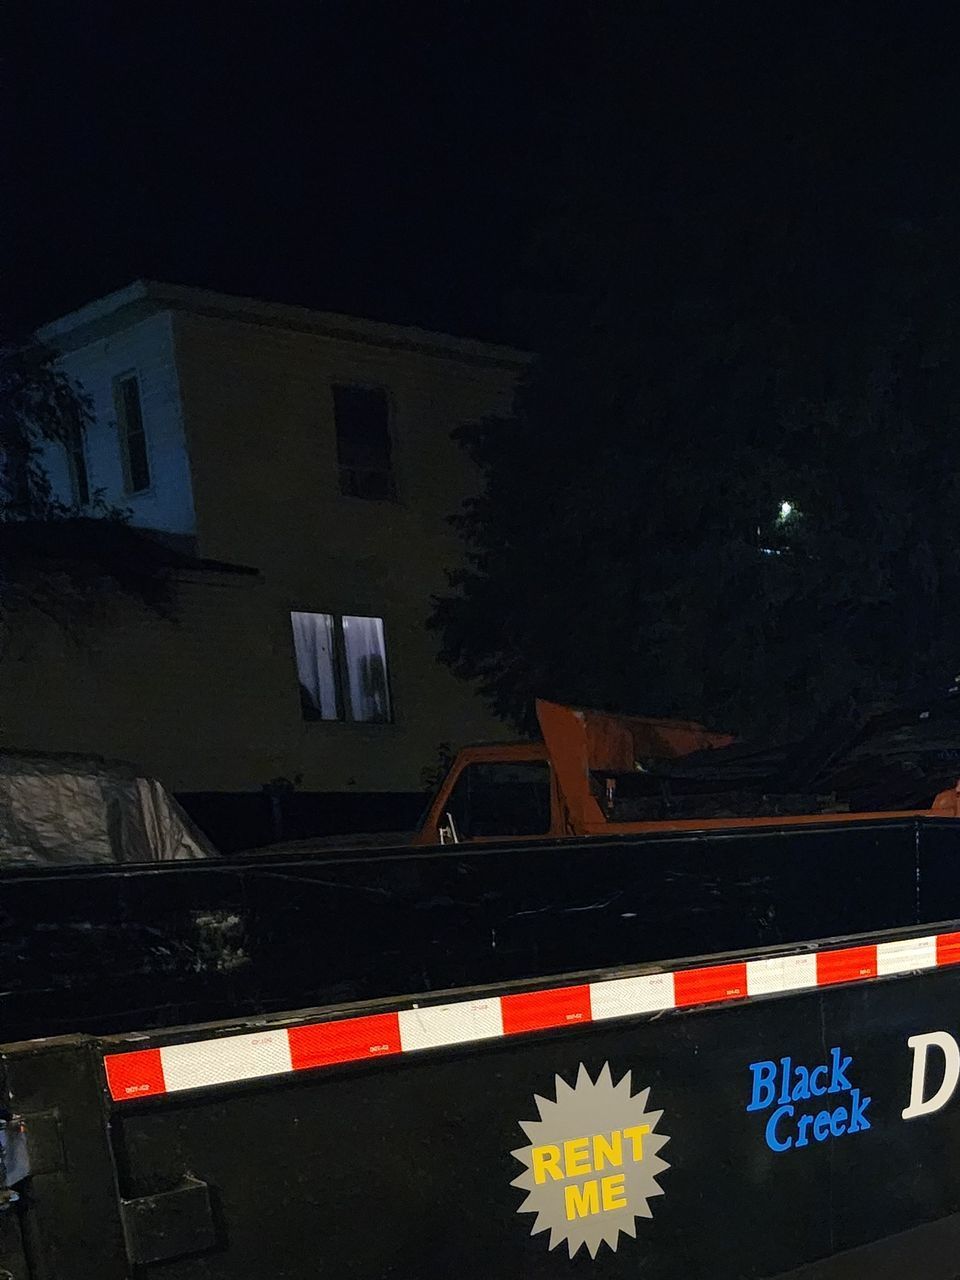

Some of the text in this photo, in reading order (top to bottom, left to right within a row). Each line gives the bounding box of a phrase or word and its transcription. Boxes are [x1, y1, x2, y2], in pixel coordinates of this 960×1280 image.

[746, 1047, 853, 1112] Black
[765, 1088, 871, 1152] Creek
[531, 1124, 650, 1185] RENT
[564, 1173, 627, 1221] ME
